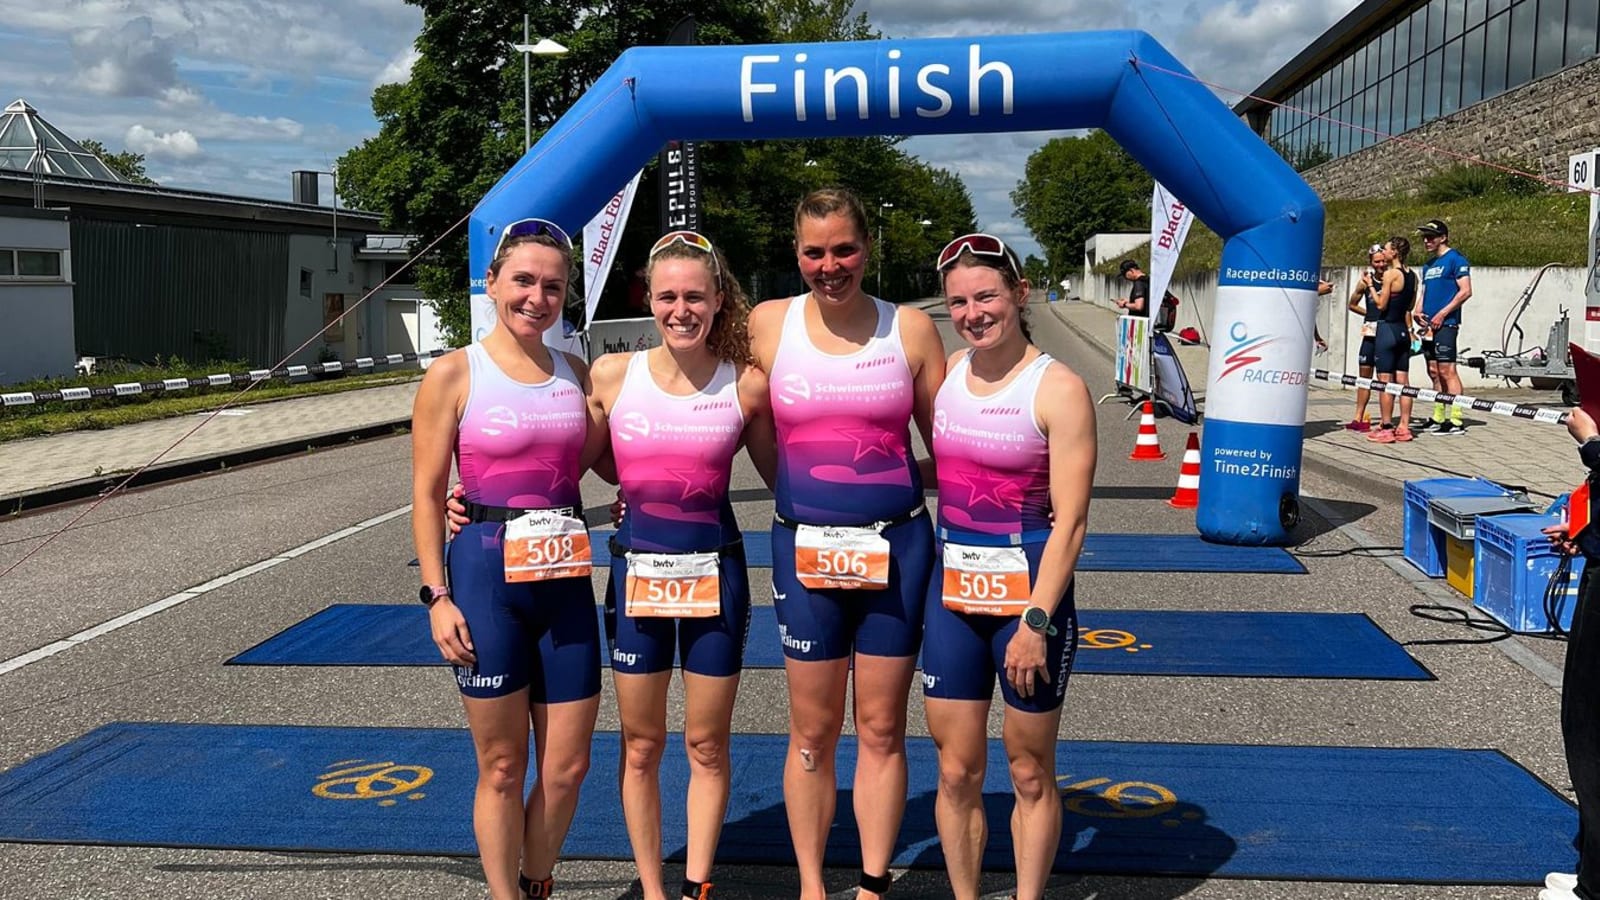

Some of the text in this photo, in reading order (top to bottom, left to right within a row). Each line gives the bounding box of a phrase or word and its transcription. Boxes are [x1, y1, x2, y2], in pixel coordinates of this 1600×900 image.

[740, 44, 1014, 122] Finish
[1574, 161, 1588, 183] 60
[591, 221, 615, 268] Black
[1214, 447, 1272, 462] powered by
[1214, 459, 1296, 480] Time2Finish
[529, 517, 552, 527] bwtv
[823, 530, 846, 539] bwtv
[527, 536, 574, 565] 508
[962, 551, 981, 561] bwtv
[653, 559, 675, 568] bwtv
[816, 550, 868, 577] 506
[647, 579, 699, 602] 507
[959, 573, 1008, 600] 505
